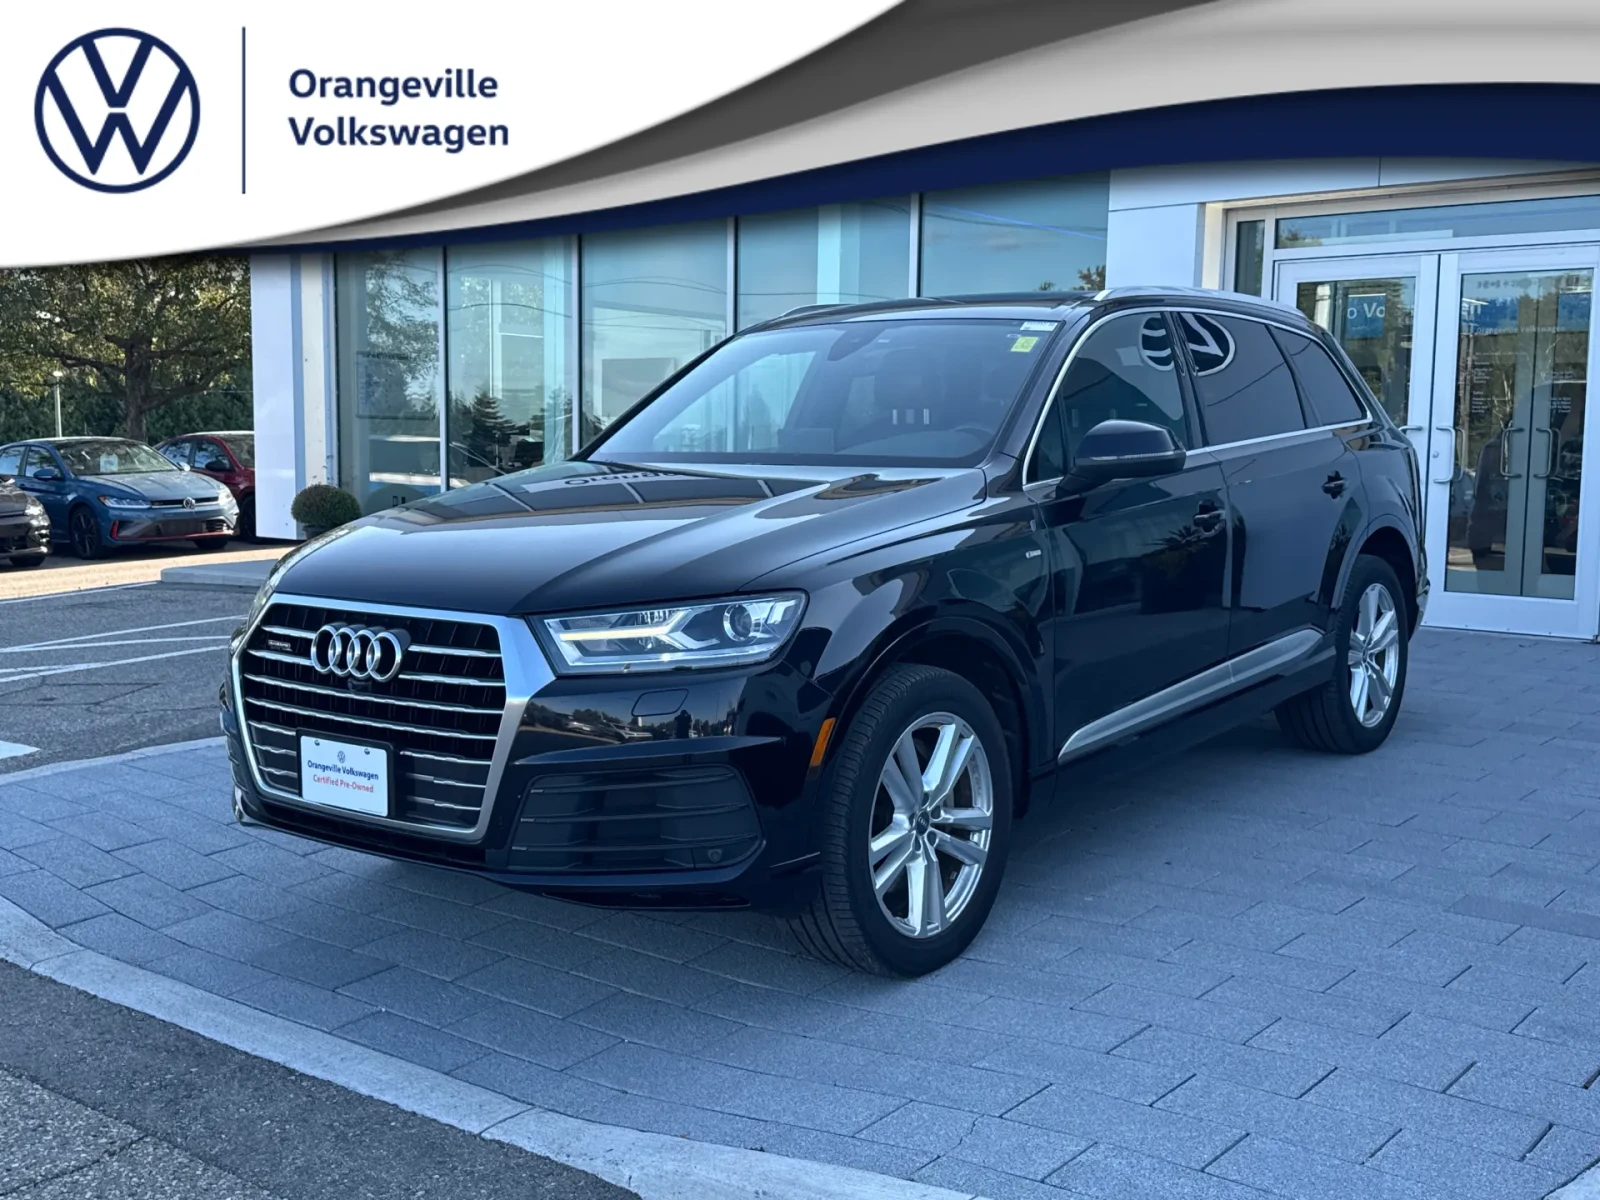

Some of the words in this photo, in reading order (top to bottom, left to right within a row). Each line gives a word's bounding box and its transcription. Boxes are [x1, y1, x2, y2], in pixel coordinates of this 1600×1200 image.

[308, 760, 341, 773] Orangeville
[342, 767, 379, 780] Volkswagen
[313, 775, 339, 786] Certified
[340, 780, 374, 793] Pre-Owned
